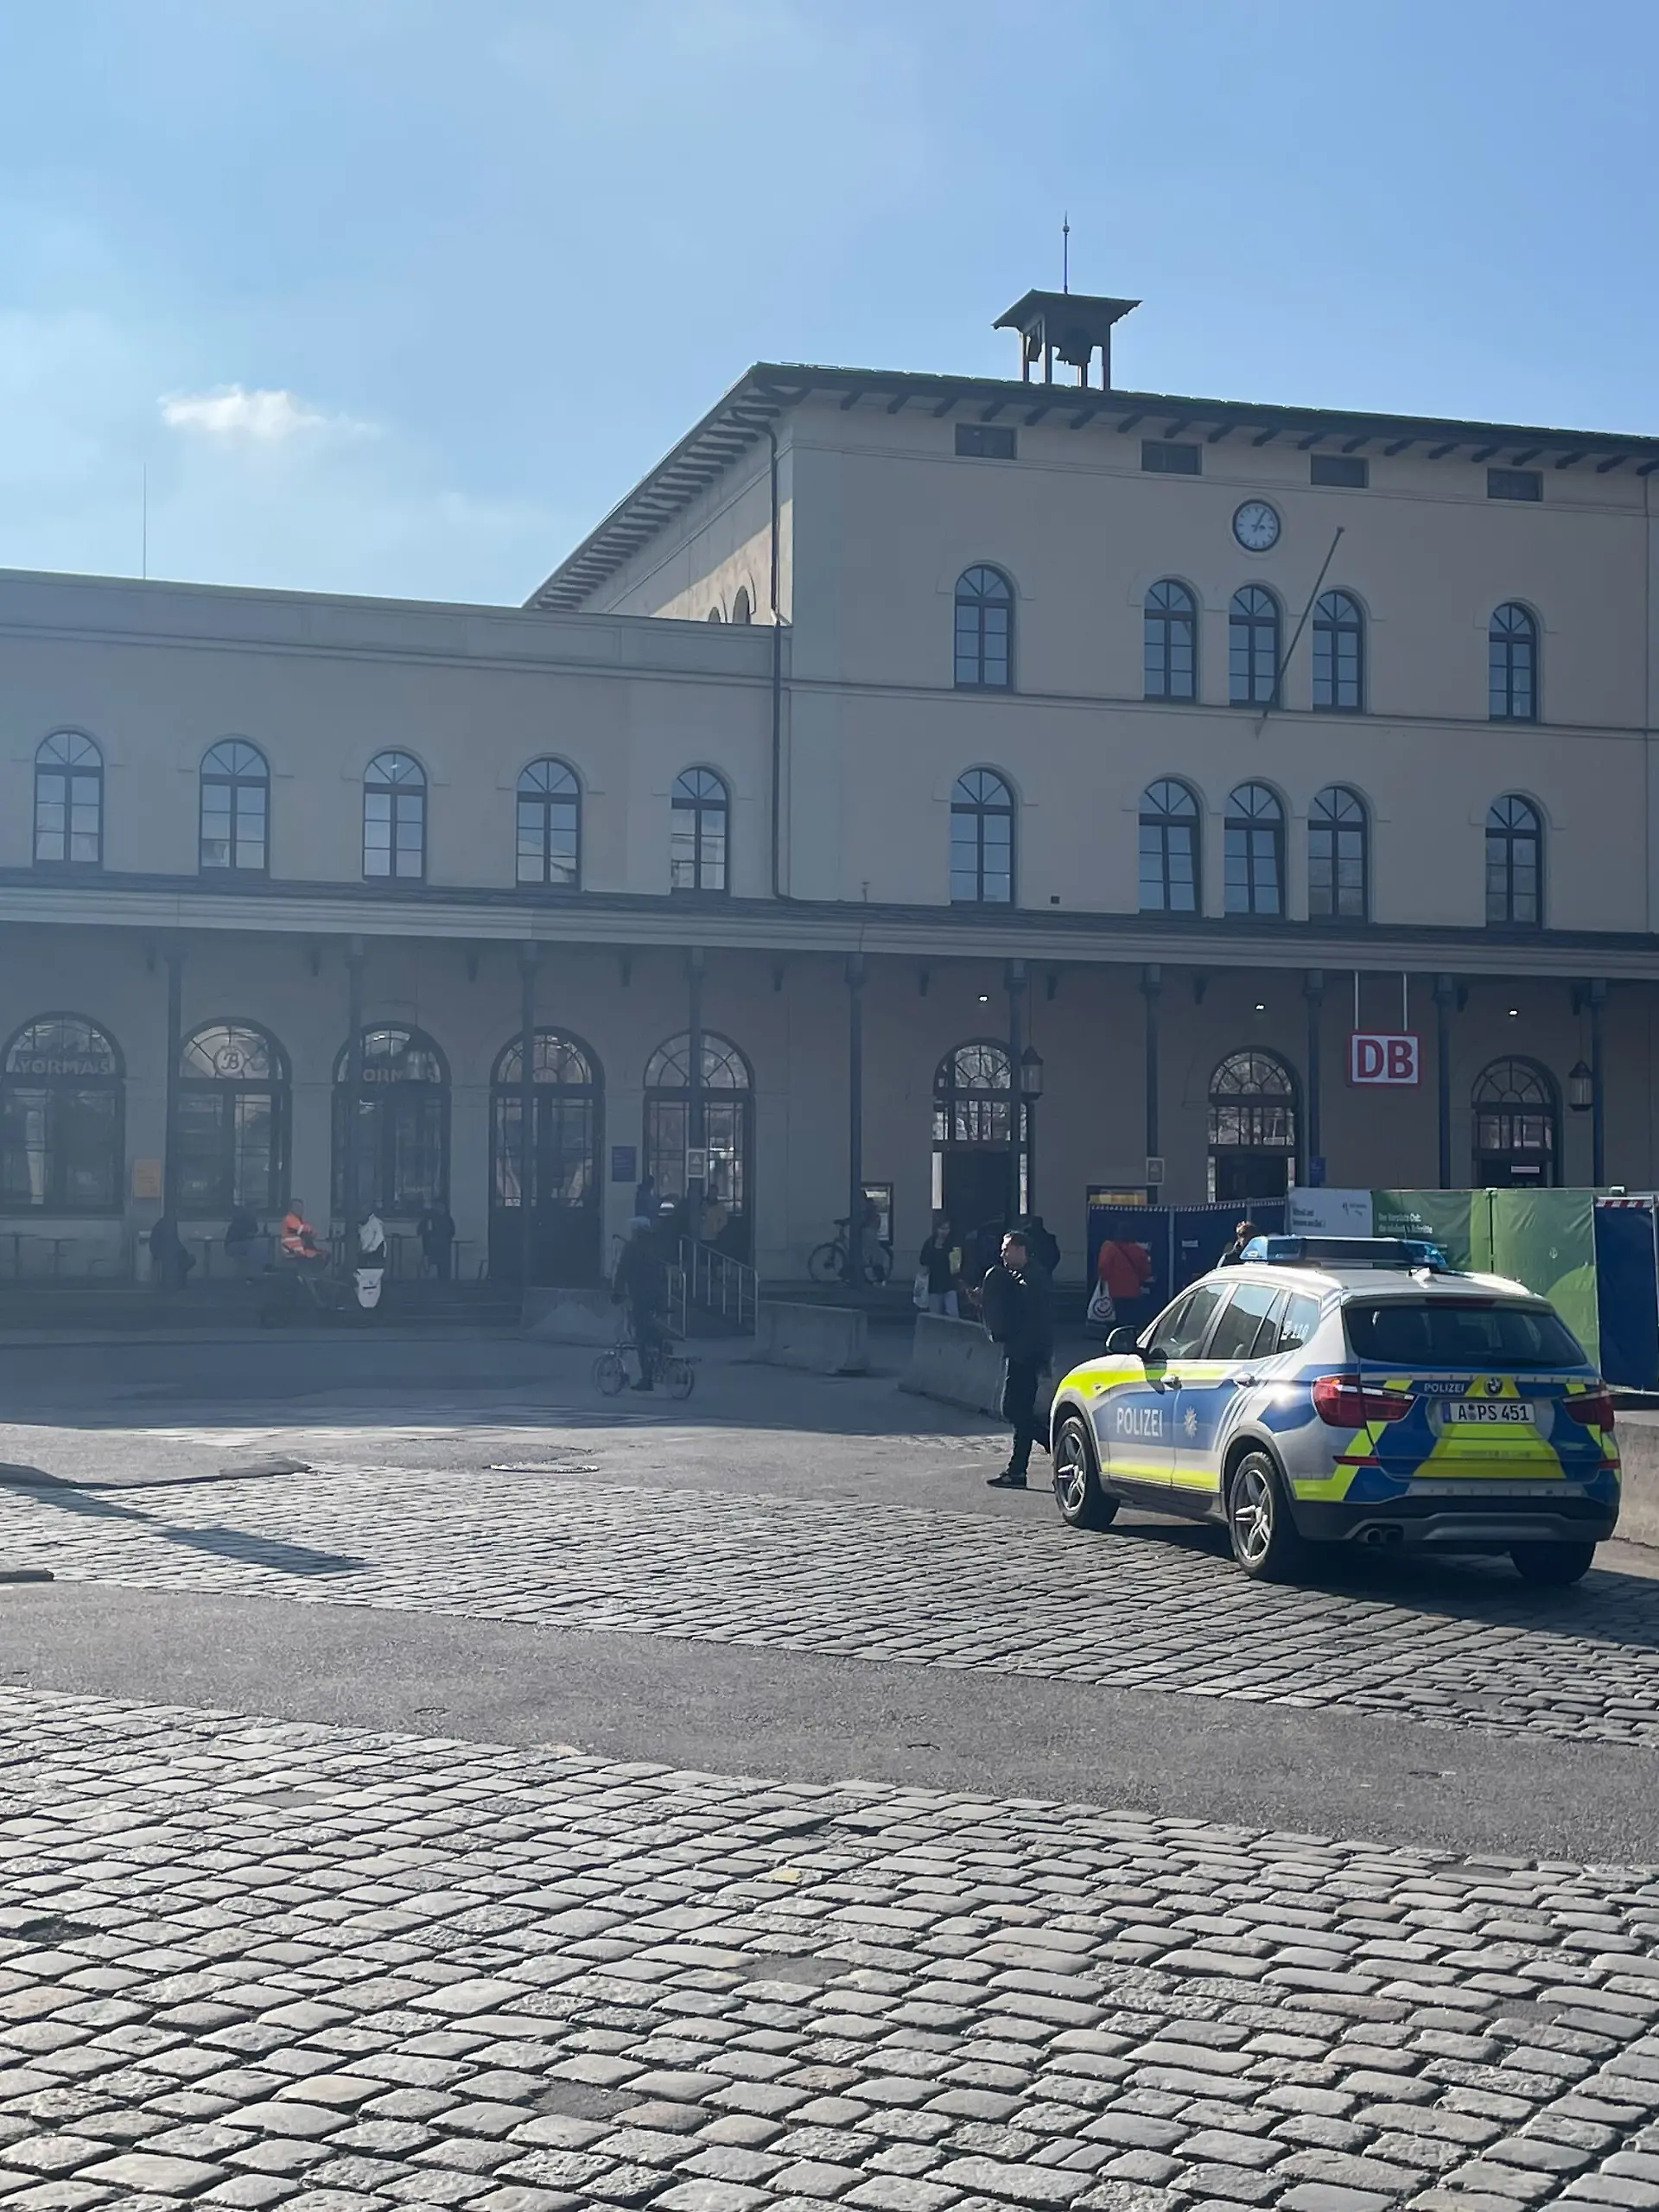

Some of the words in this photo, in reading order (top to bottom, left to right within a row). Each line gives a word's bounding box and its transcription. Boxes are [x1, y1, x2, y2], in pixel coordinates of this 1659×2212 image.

[1357, 1039, 1414, 1078] DB
[1424, 1382, 1465, 1394] POLIZEI
[1116, 1407, 1163, 1438] POLIZEI
[1459, 1405, 1467, 1420] A
[1478, 1405, 1497, 1421] PS
[1502, 1405, 1529, 1421] 451
